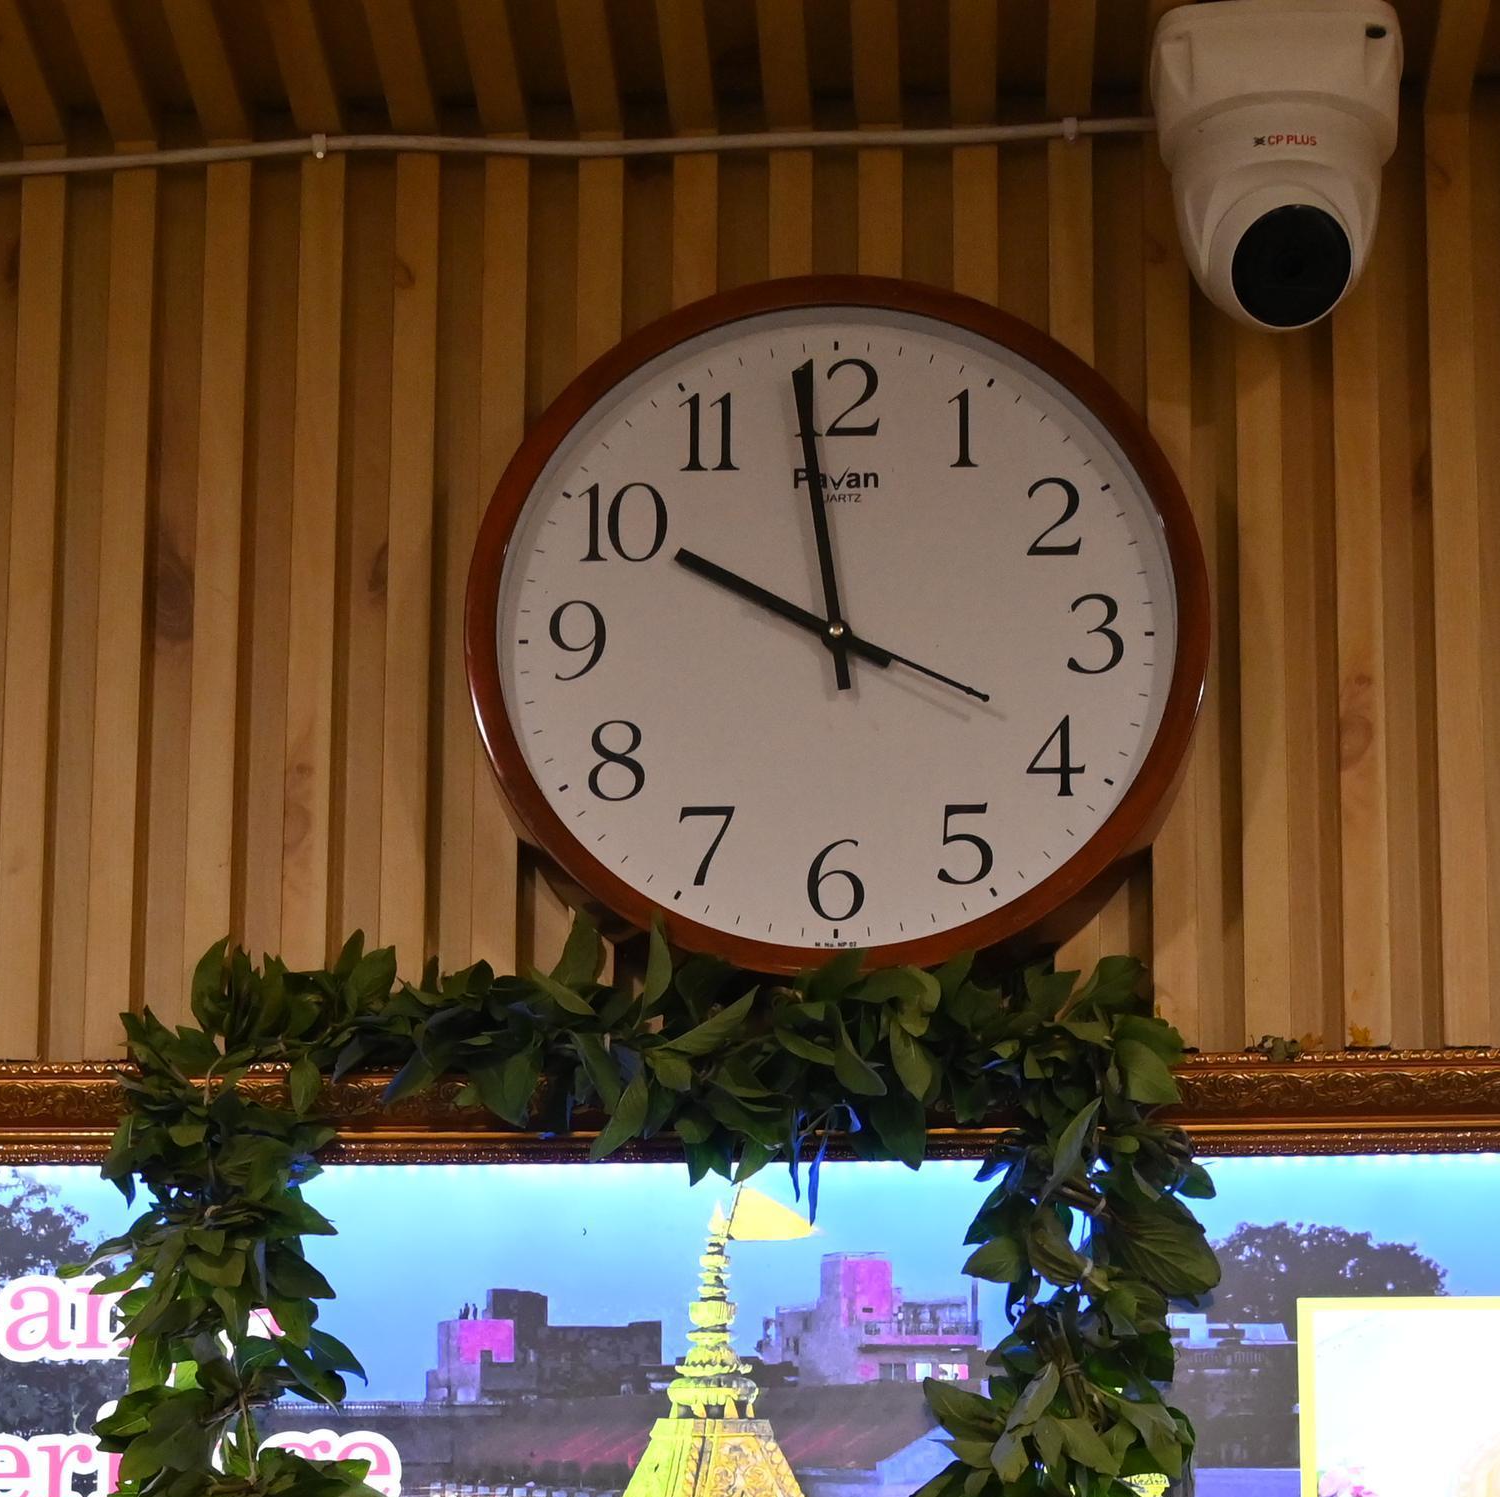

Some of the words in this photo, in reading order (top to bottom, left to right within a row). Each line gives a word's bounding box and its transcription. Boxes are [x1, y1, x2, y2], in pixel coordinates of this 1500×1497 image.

[1267, 134, 1284, 145] CP
[1286, 134, 1317, 146] PLUS
[679, 391, 740, 471] 11
[948, 388, 979, 468] 1
[578, 483, 668, 562] 10
[1026, 477, 1082, 556] 2
[548, 600, 607, 681] 9
[1066, 593, 1125, 674] 3
[587, 720, 646, 801] 8
[1025, 714, 1086, 797] 4
[678, 806, 736, 886] 7
[807, 838, 865, 921] 6
[937, 802, 994, 885] 5
